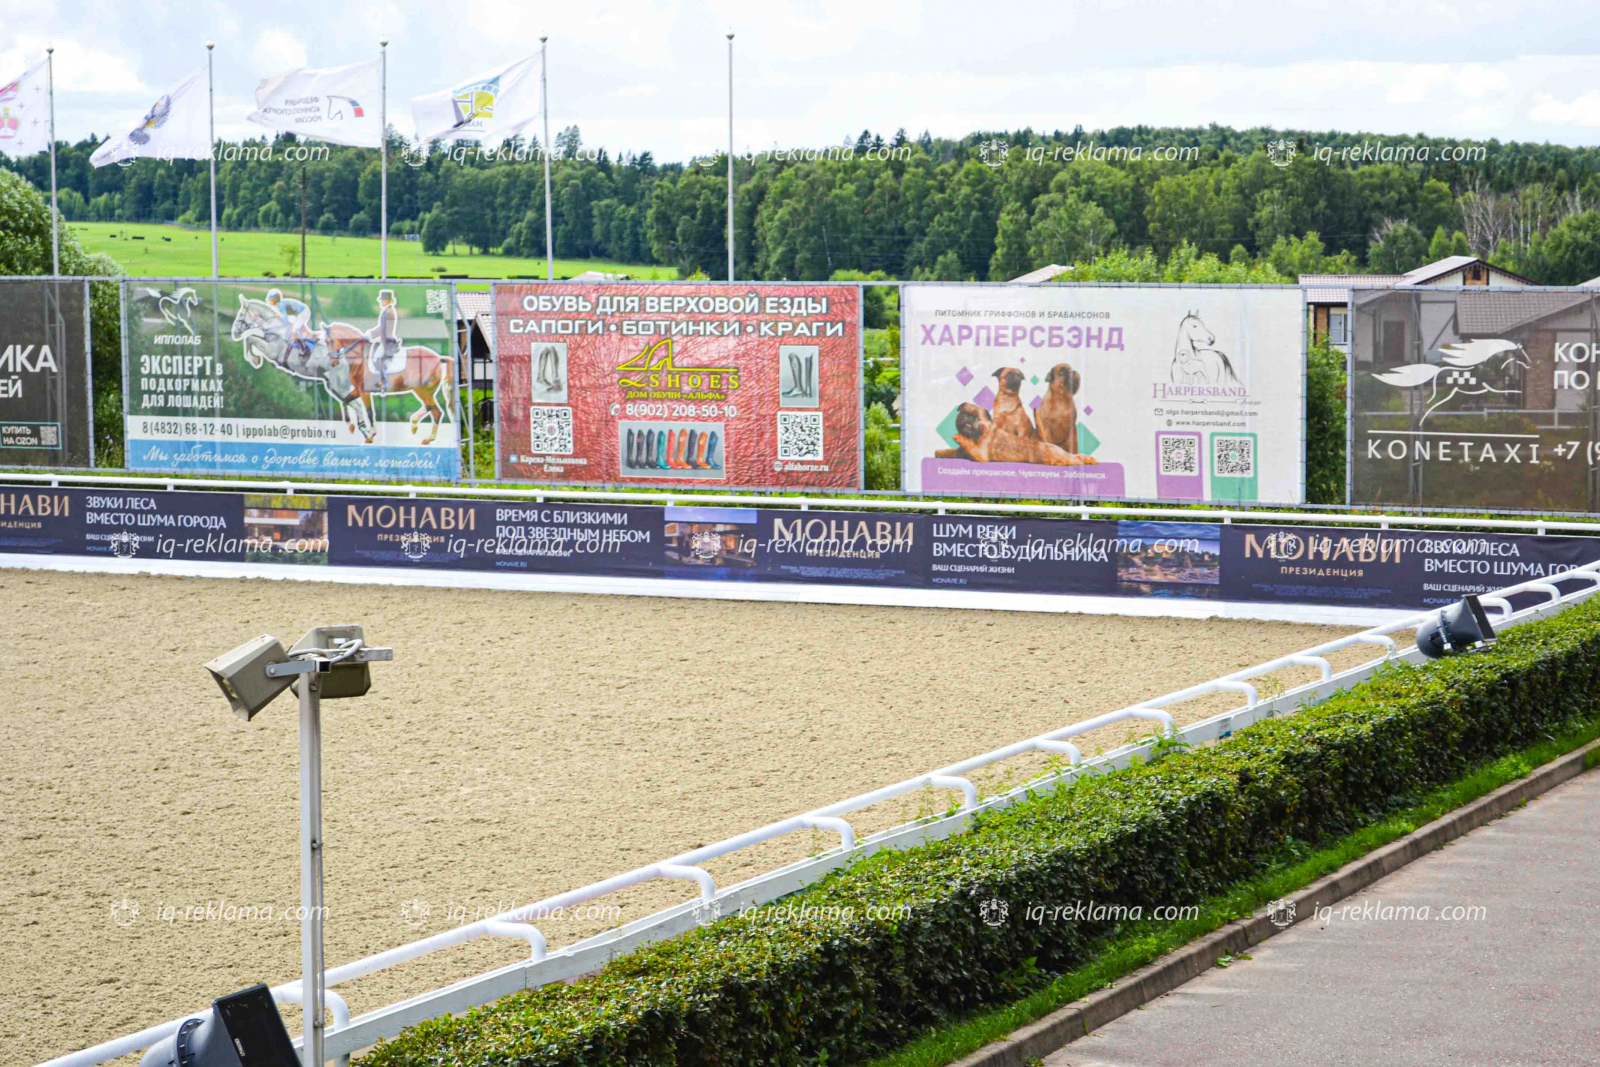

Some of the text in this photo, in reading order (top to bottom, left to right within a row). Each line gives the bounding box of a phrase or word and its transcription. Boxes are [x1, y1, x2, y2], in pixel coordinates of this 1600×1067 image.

[522, 293, 828, 316] ОБУВЬ ДЛЯ ВЕРХОВОЙ ЕЗДЫ
[934, 309, 1111, 320] ПИТОМНИК ГРИФФОНОВ И БРАБАНСОНОВ
[509, 318, 844, 337] САПОГИ БОТИНКИ КРАГИ
[154, 335, 202, 345] ИППОЛАБ
[920, 324, 1125, 351] ХАРПЕРСБЭНД
[140, 355, 213, 375] ЭКСПЕРТ
[141, 378, 224, 393] ПОДКОРМКАХ
[1553, 370, 1590, 390] ПО
[141, 394, 224, 411] ДЛЯ ЛОШАДЕЙ!
[627, 391, 648, 400] ДОМ
[649, 391, 681, 400] ОБУВИ
[626, 403, 738, 418] 8(902) 208-50-10
[2, 426, 31, 435] КУПИТЬ
[242, 424, 336, 441] ippolab@probio.ru
[3, 437, 38, 446] НА OZON
[143, 445, 169, 462] Мы
[171, 444, 247, 467] заботимся
[262, 448, 318, 470] здоровье
[321, 449, 371, 467] ваших
[1367, 439, 1541, 464] KONETAXI
[1553, 441, 1580, 460] +7
[85, 496, 157, 510] ЗВУКИ ЛЕСА
[85, 512, 227, 530] ВМЕСТО ШУМА ГОРОДА
[347, 504, 475, 530] МОНАВИ
[496, 508, 628, 525] ВРЕМЯ С БЛИЗКИМИ
[496, 525, 650, 543] ПОД ЗВЕЗДНЫМ НЕБОМ
[773, 518, 914, 546] МОНАВИ
[933, 523, 1016, 540] ШУМ РЕКИ
[806, 549, 881, 560] ПРЕЗИДЕНЦИЯ
[932, 542, 1109, 562] ВМЕСТО БУДИЛЬНИКА
[1244, 534, 1401, 563] МОНАВИ
[1477, 541, 1520, 557] ЛЕСА
[932, 564, 1015, 574] ВАШ СЦЕНАРИЙ ЖИЗНИ
[1280, 566, 1364, 577] ПРЕЗИДЕНЦИЯ
[1424, 559, 1490, 574] ВМЕСТО
[1493, 562, 1545, 576] ШУМА
[1423, 583, 1441, 591] ВАШ
[1442, 584, 1485, 593] СЦЕНАРИЙ
